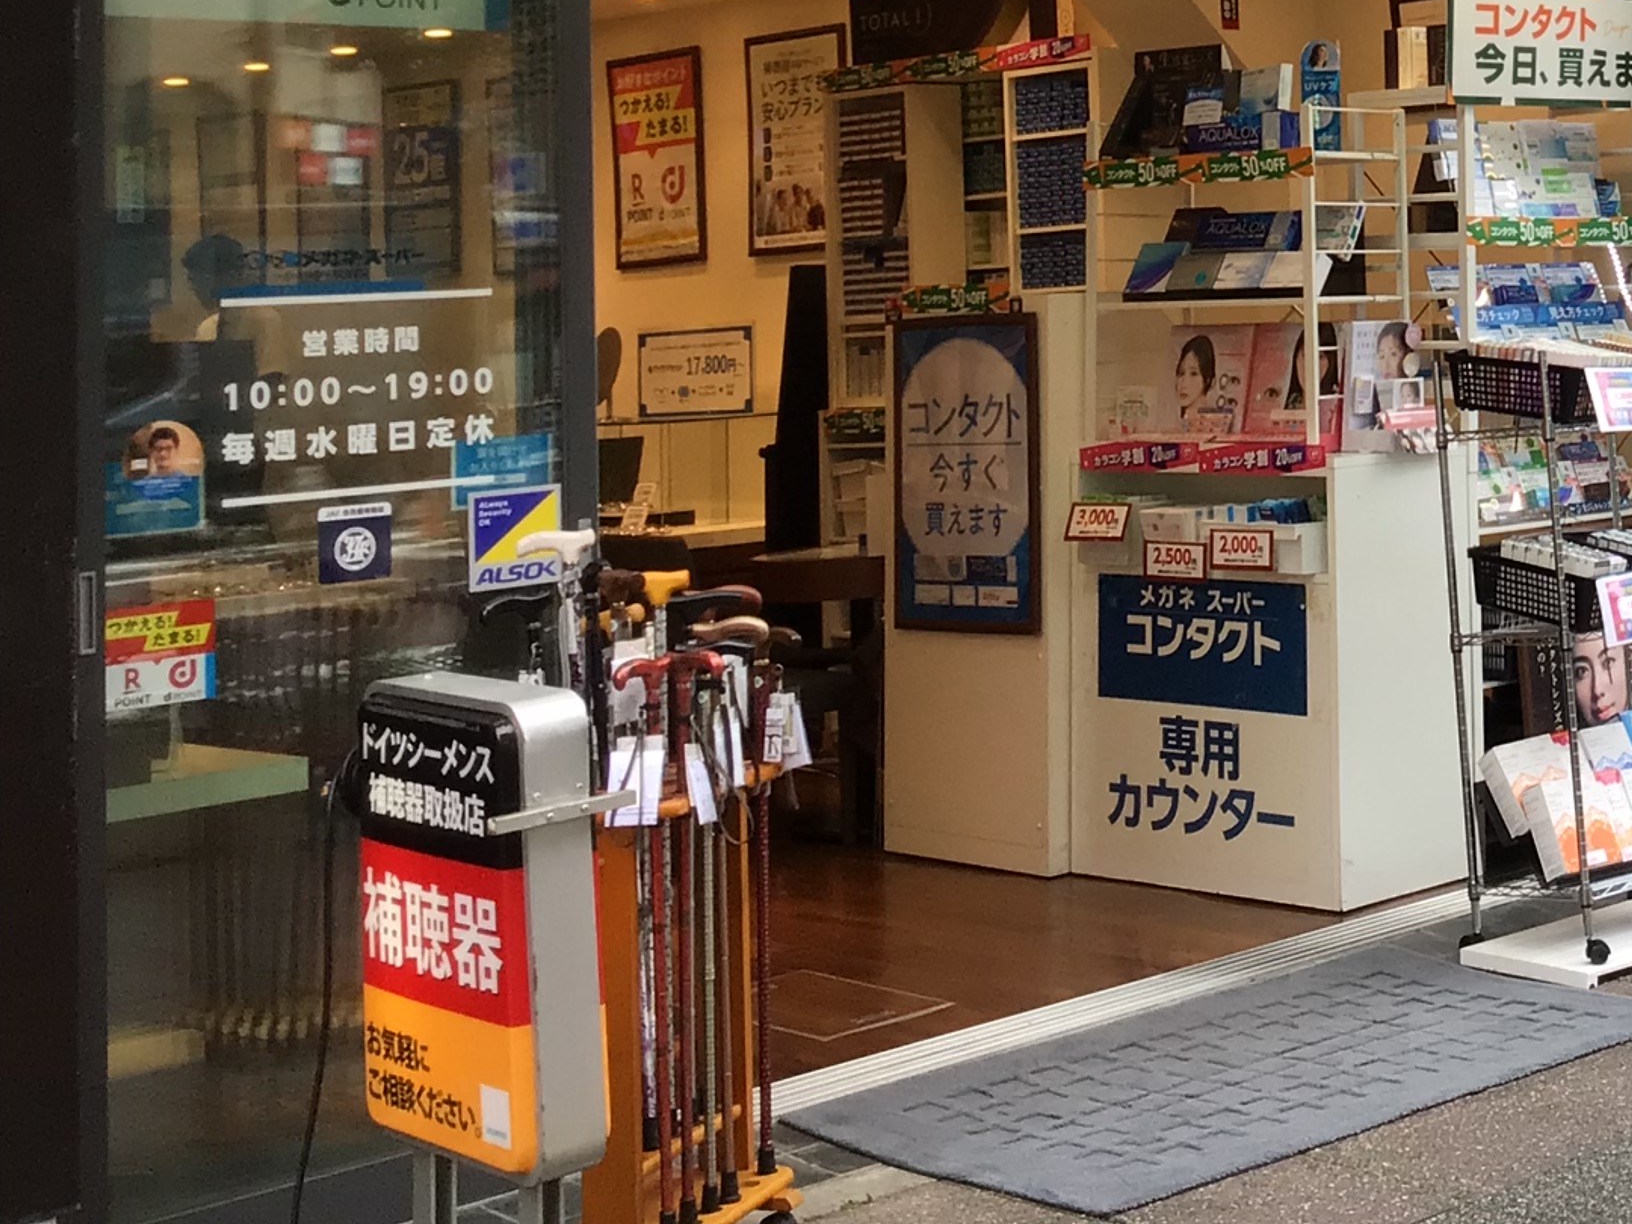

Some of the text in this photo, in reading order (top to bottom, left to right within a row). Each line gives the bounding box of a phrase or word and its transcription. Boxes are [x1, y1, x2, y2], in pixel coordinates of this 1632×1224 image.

[1475, 2, 1598, 42] コンタクト
[1241, 155, 1287, 177] 50%OFF
[1519, 222, 1554, 242] 50%OFF
[302, 325, 420, 358] 営業時間
[907, 392, 1021, 439] コンタクト
[221, 414, 496, 466] 毎週水曜日定休
[928, 457, 1001, 493] 今すぐ
[924, 501, 1008, 539] 買えます
[476, 560, 557, 586] ALSOK
[1139, 584, 1266, 616] メガネ スーパー
[107, 615, 173, 634] つかえる!
[1125, 614, 1282, 667] コンタクト
[114, 693, 152, 708] POINT
[360, 721, 495, 785] ドイツシーメンス
[1158, 715, 1240, 781] 専用
[368, 772, 486, 839] 補聴器取扱店
[1107, 774, 1296, 841] カウンター
[362, 867, 504, 995] 補聴器
[366, 1021, 431, 1073] お気軽に
[367, 1067, 483, 1138] ご相談ください。
